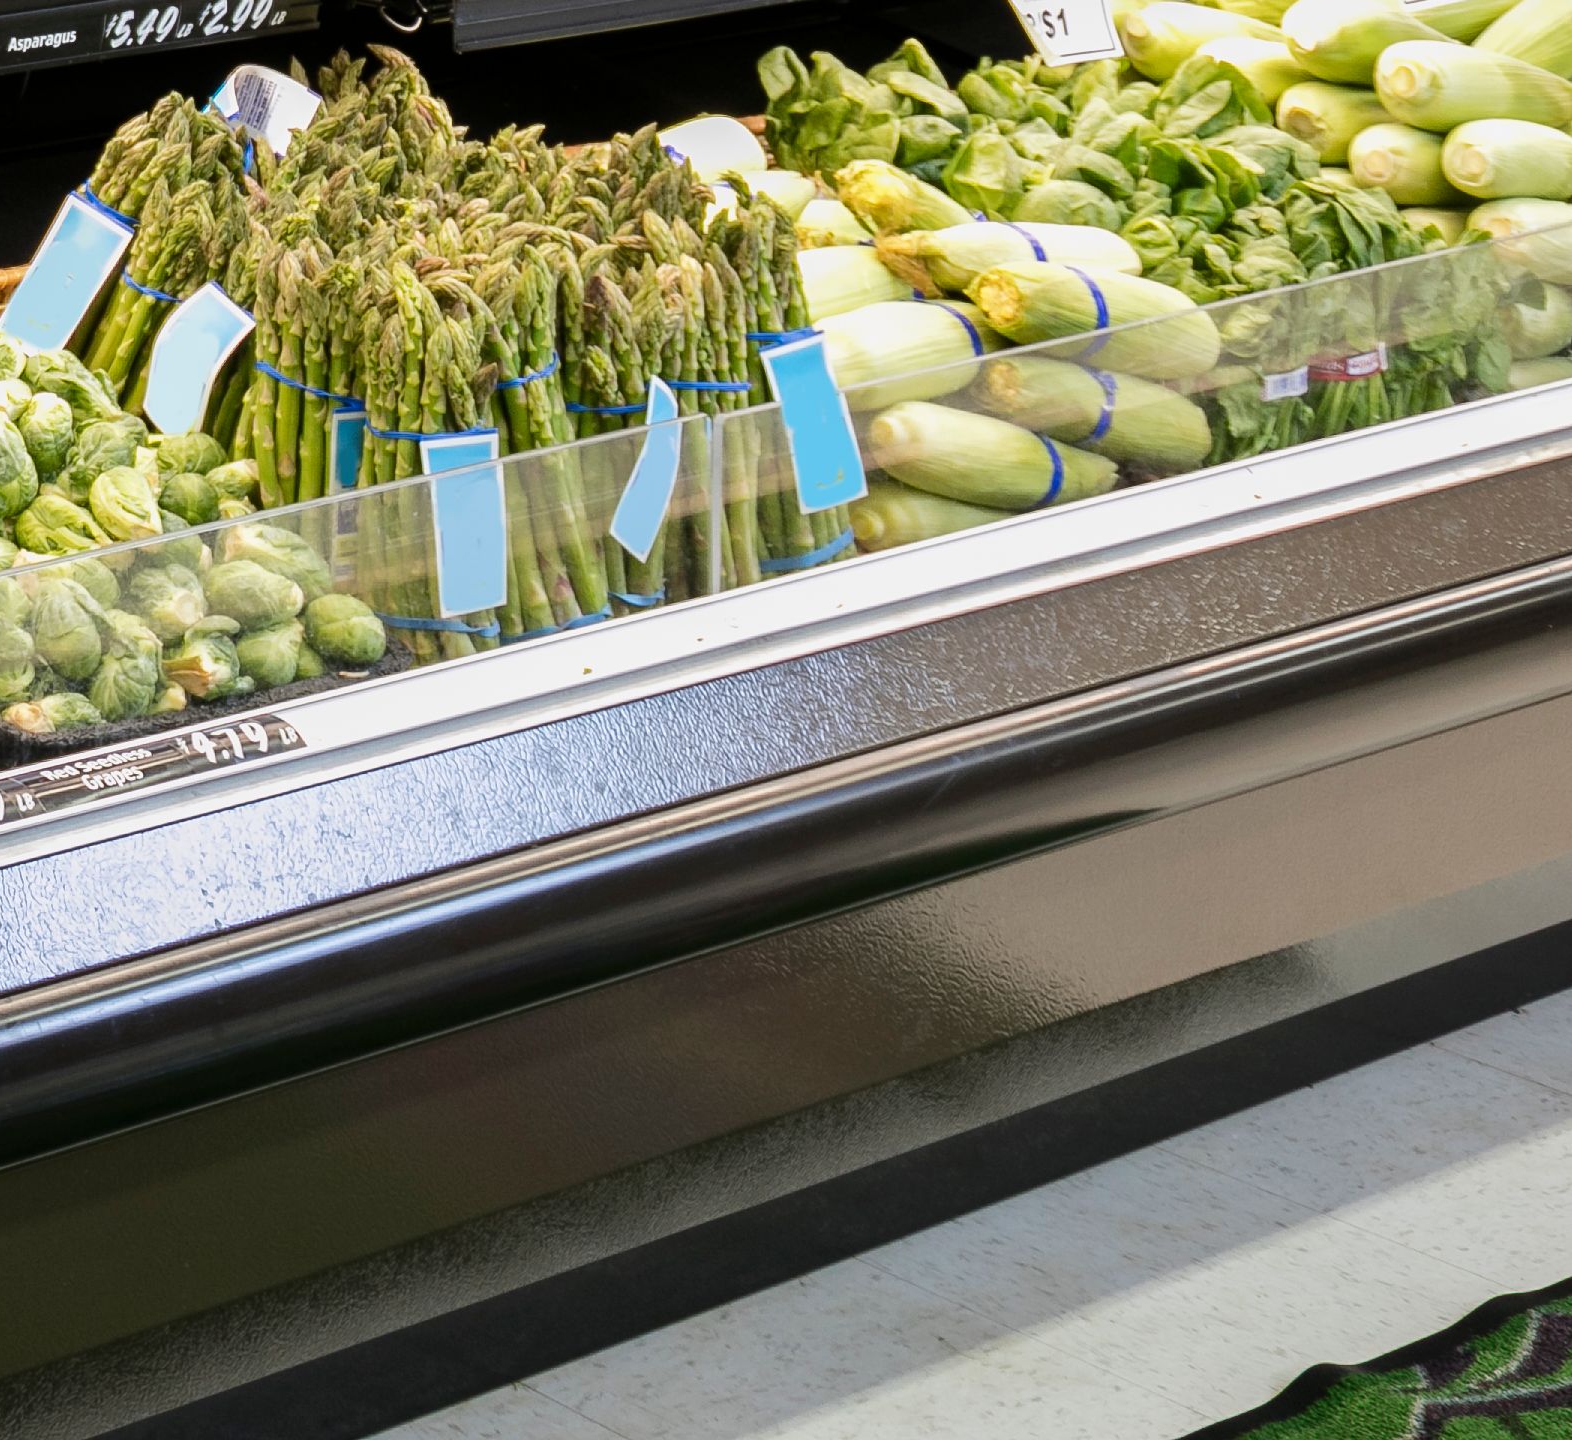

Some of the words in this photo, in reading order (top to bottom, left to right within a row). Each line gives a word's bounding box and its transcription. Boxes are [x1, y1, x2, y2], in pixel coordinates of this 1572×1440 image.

[45, 762, 83, 783] Red
[86, 744, 152, 774] Seedless
[83, 765, 144, 790] Grapes
